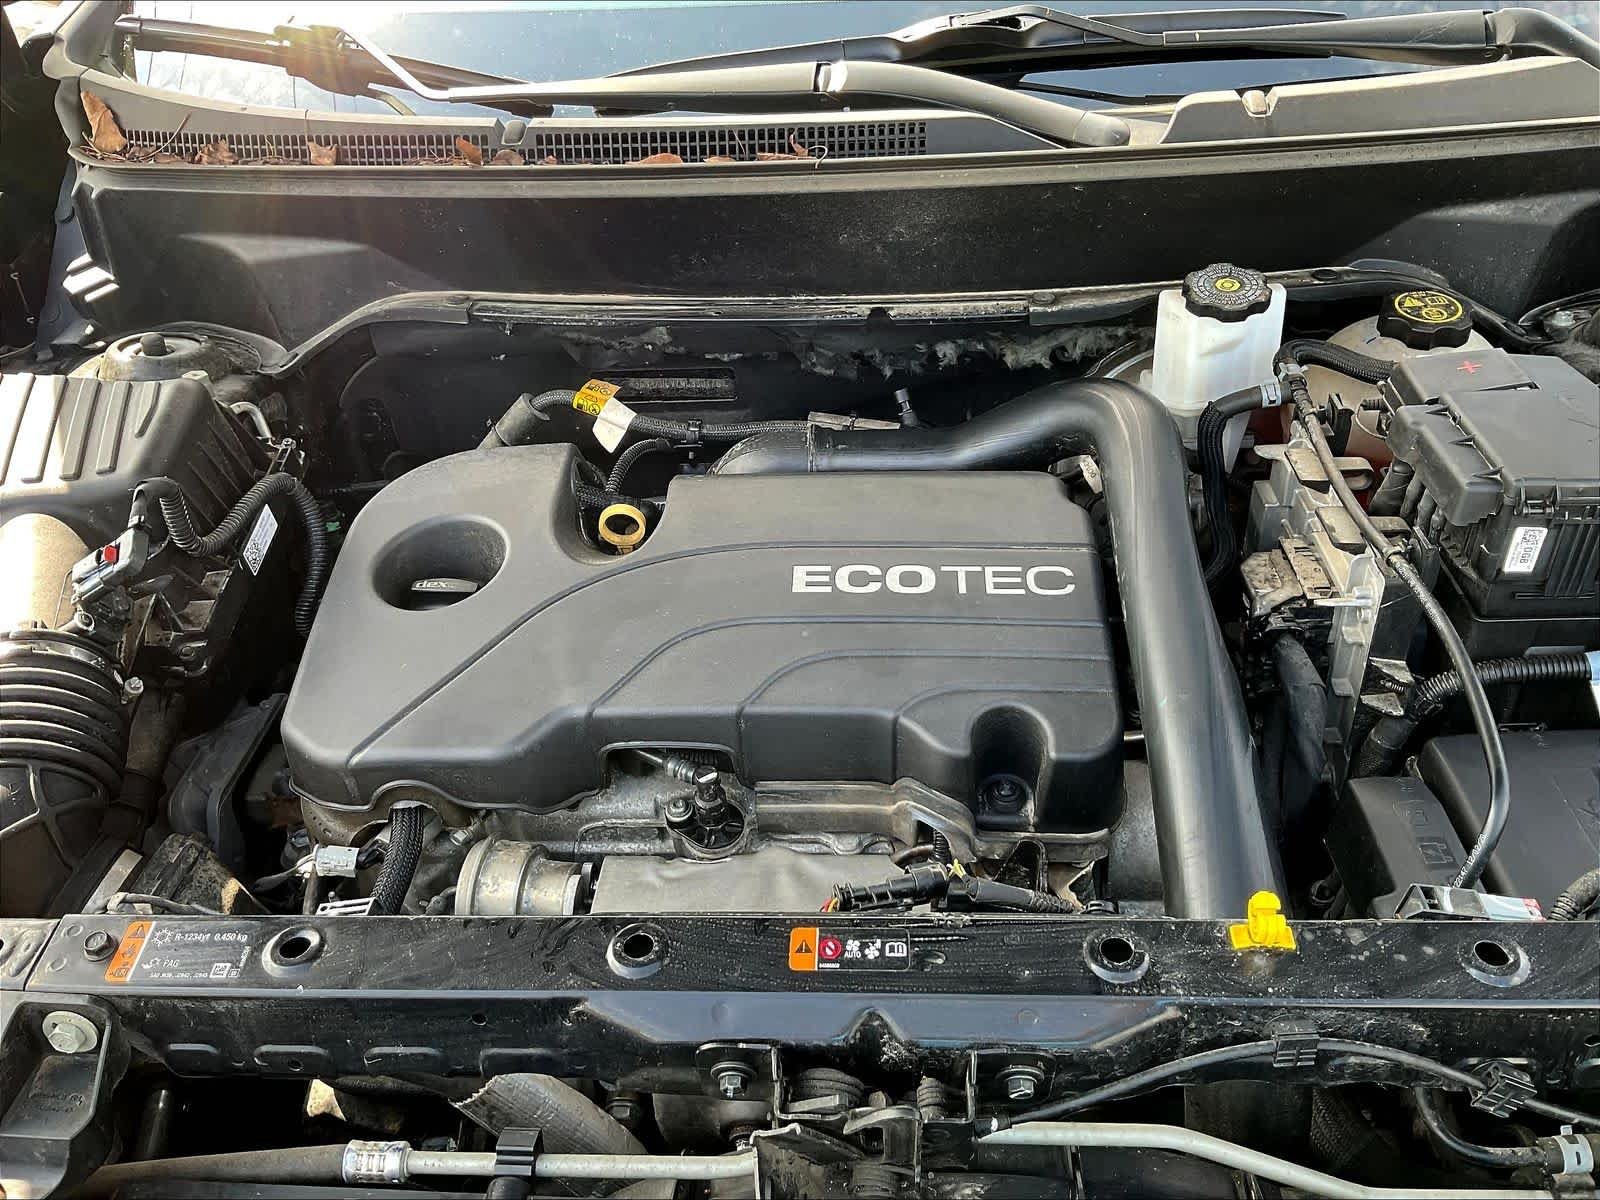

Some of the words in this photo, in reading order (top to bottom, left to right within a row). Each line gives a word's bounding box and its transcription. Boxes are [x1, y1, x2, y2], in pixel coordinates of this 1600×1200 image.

[791, 564, 1077, 597] ECOTEC
[174, 933, 211, 942] R-1234yf
[214, 932, 236, 941] 0.450
[844, 951, 862, 959] AUTO
